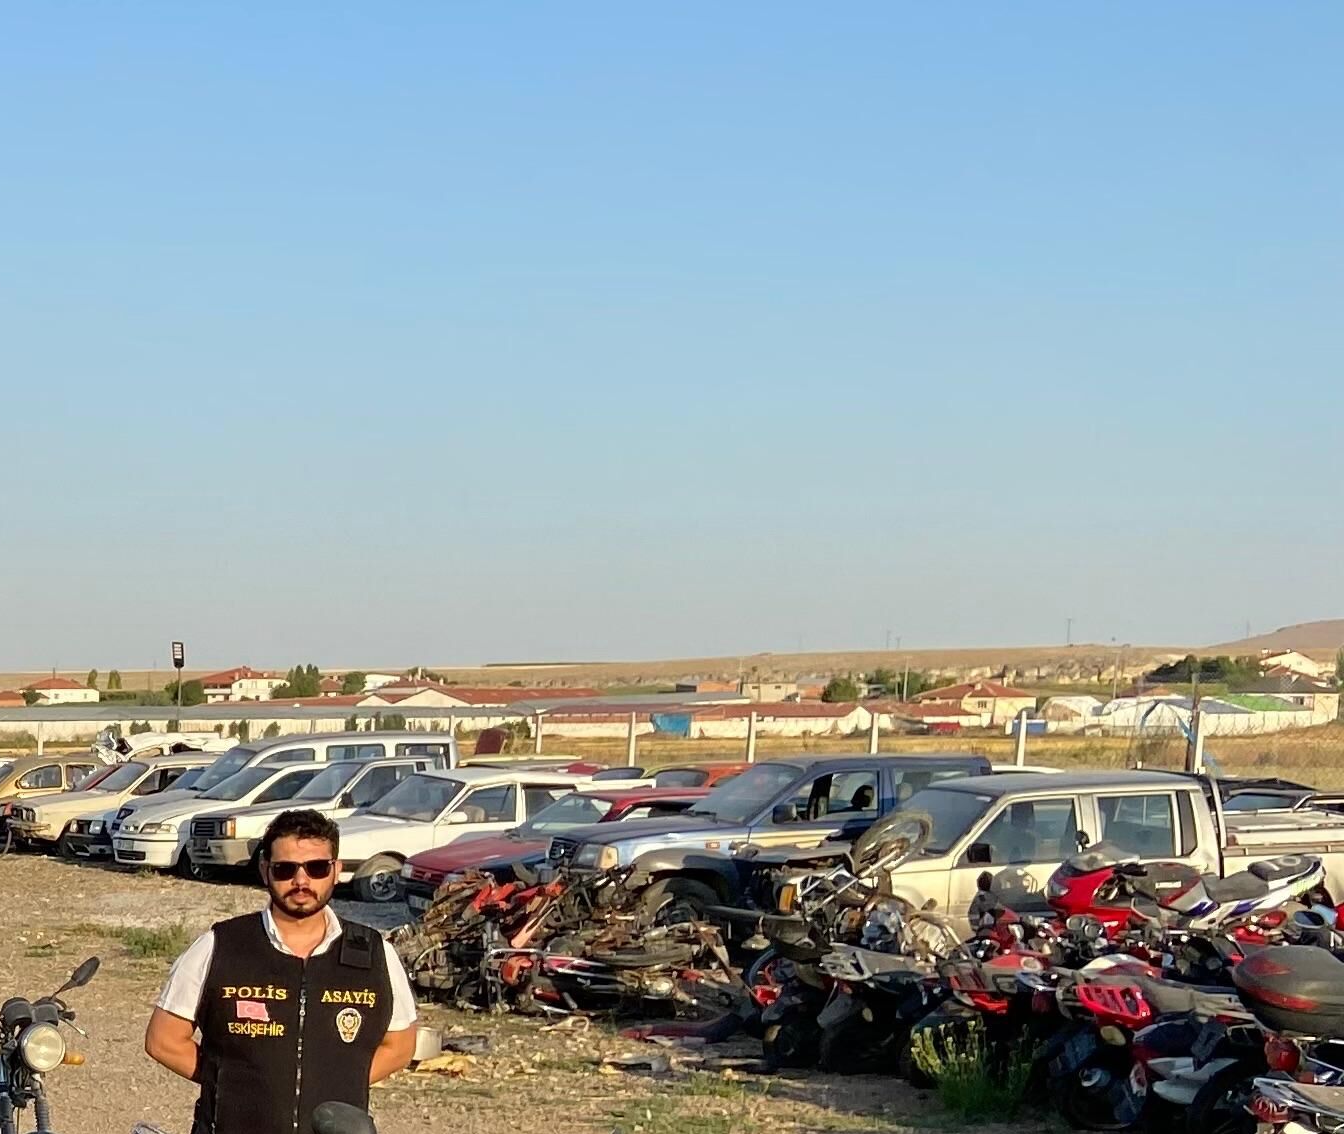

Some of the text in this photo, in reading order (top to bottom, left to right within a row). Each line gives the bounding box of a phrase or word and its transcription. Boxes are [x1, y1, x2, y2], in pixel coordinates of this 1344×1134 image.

[221, 985, 376, 1008] POLİS ASAYİŞ
[227, 1020, 285, 1038] ESKİŞEHİR
